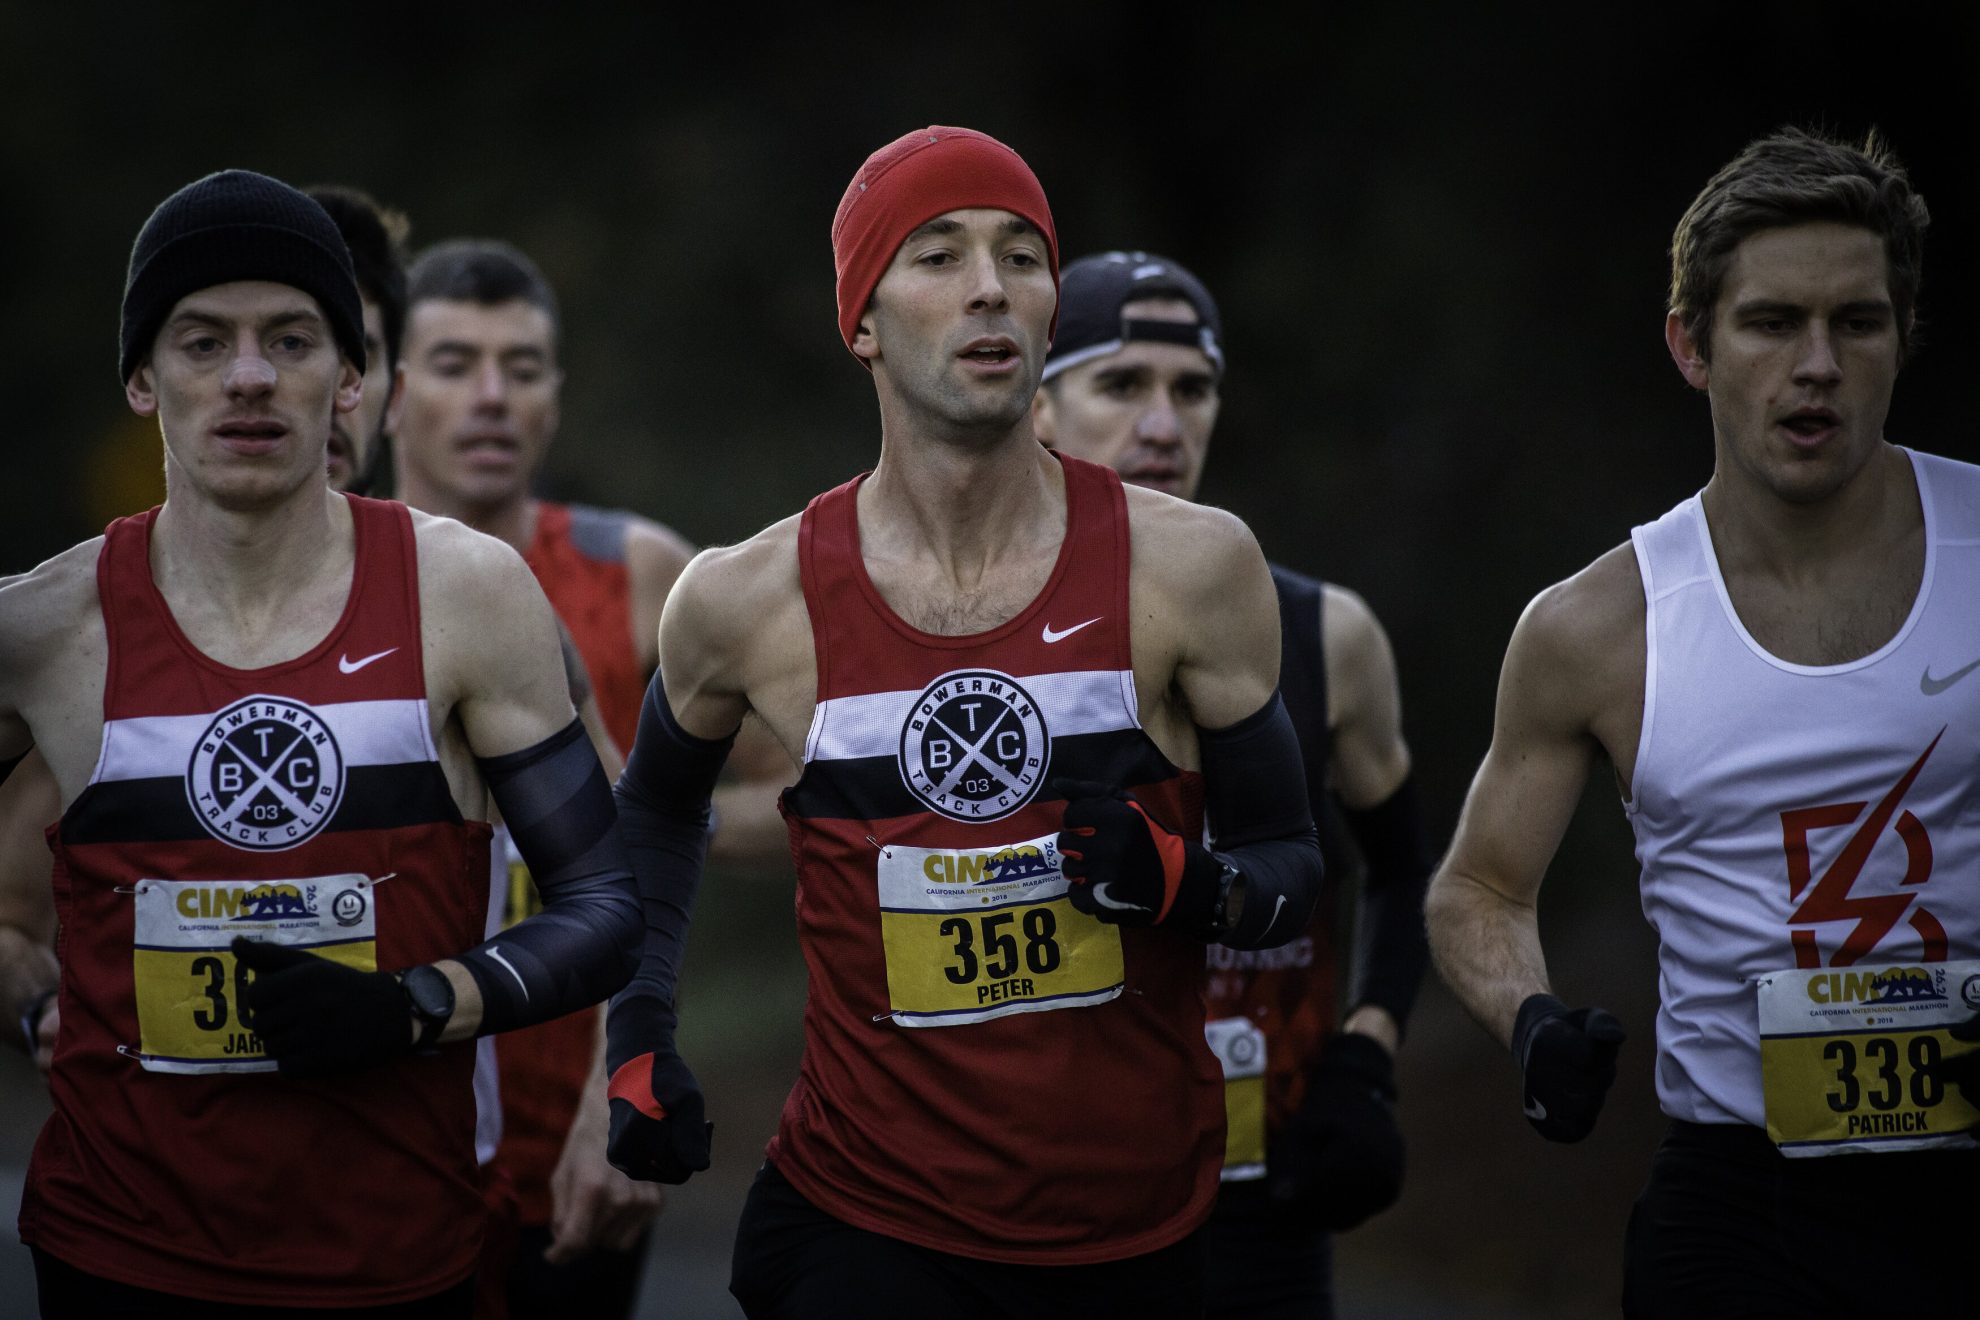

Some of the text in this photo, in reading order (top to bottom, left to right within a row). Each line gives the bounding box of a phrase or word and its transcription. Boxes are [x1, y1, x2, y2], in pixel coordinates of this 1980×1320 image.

[911, 680, 1032, 731] BOWERMAN
[203, 706, 327, 753] BOWERMAN
[912, 757, 1040, 814] TRACK CLUB
[966, 779, 990, 793] 03
[200, 785, 332, 842] TRACK CLUB
[253, 804, 279, 820] 03
[923, 854, 995, 884] CIM
[1044, 841, 1058, 868] 26.2
[306, 885, 318, 914] 26.2
[926, 874, 1062, 896] CALIFORNIA INTERNATIONAL MARATHON
[992, 894, 1008, 902] 2018
[176, 887, 252, 918] CIM
[939, 908, 1060, 984] 358
[977, 978, 1035, 1004] PETER
[1807, 971, 1879, 1004] CIM
[1935, 969, 1947, 996] 26.2
[1809, 1008, 1850, 1017] CALIFORNIA
[1908, 1001, 1949, 1012] MARATHON
[1823, 1036, 1944, 1112] 338
[1848, 1111, 1929, 1135] PATRICK
